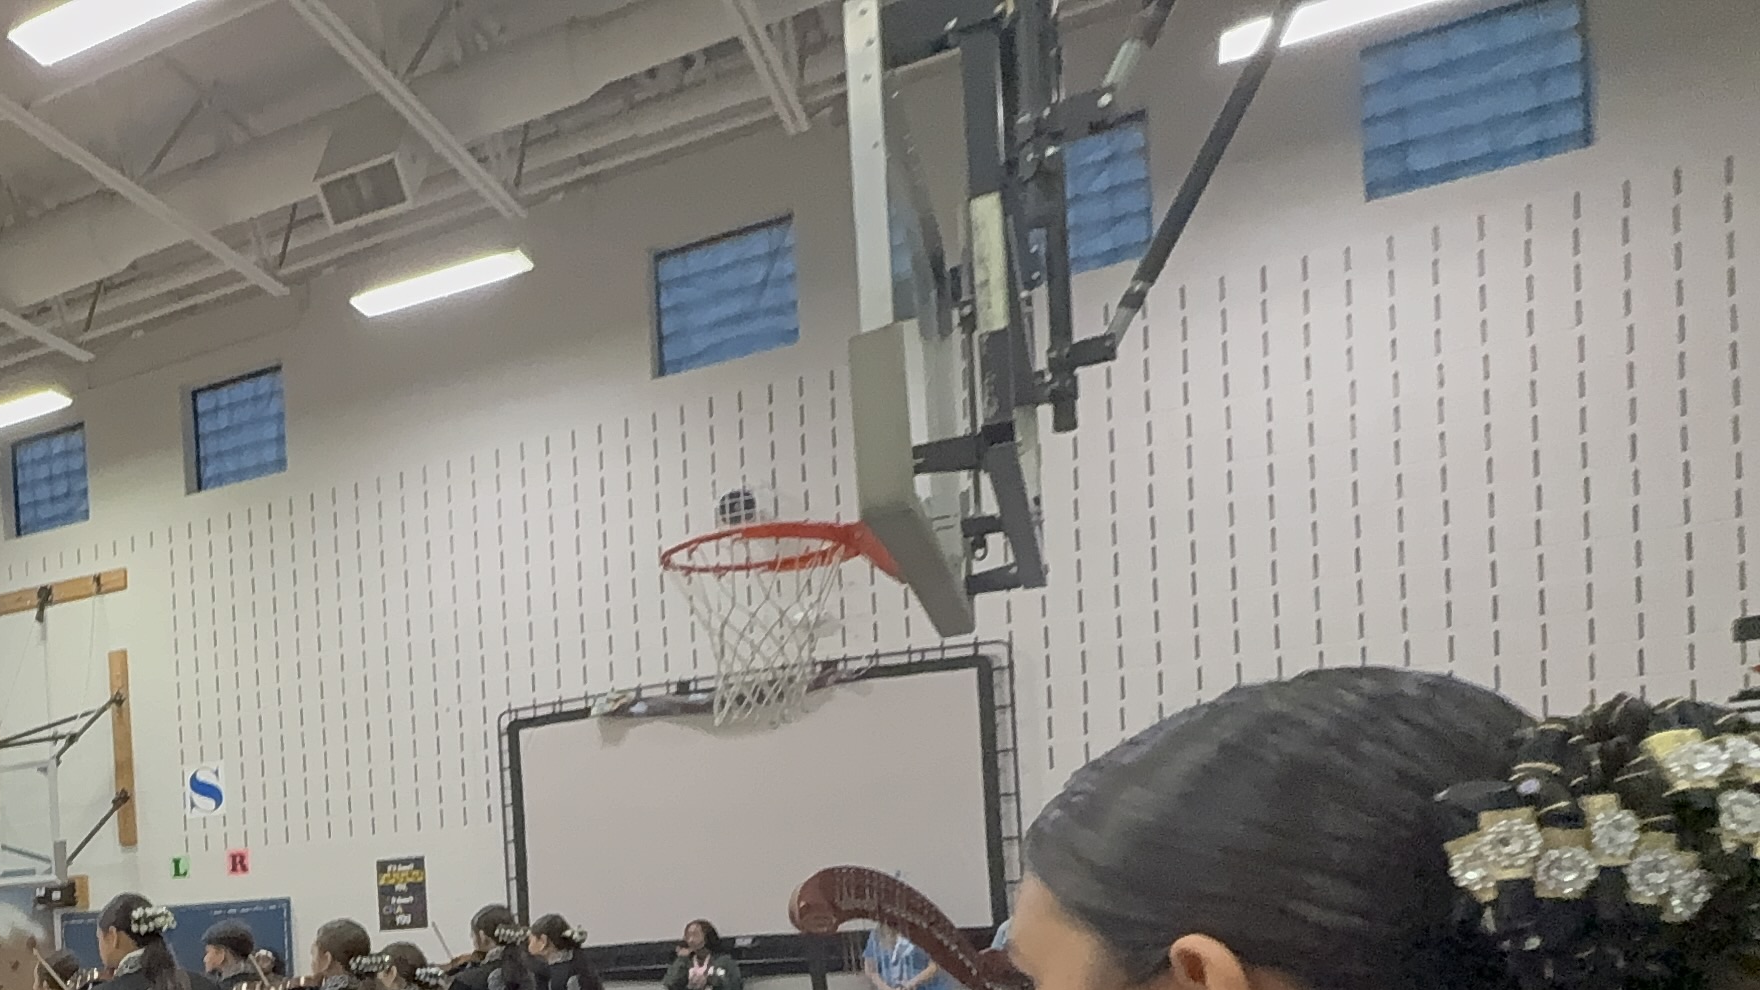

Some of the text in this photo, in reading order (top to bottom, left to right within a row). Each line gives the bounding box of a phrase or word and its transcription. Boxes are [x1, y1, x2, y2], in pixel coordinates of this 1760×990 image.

[189, 766, 223, 813] S
[172, 858, 188, 877] L
[230, 852, 249, 873] R
